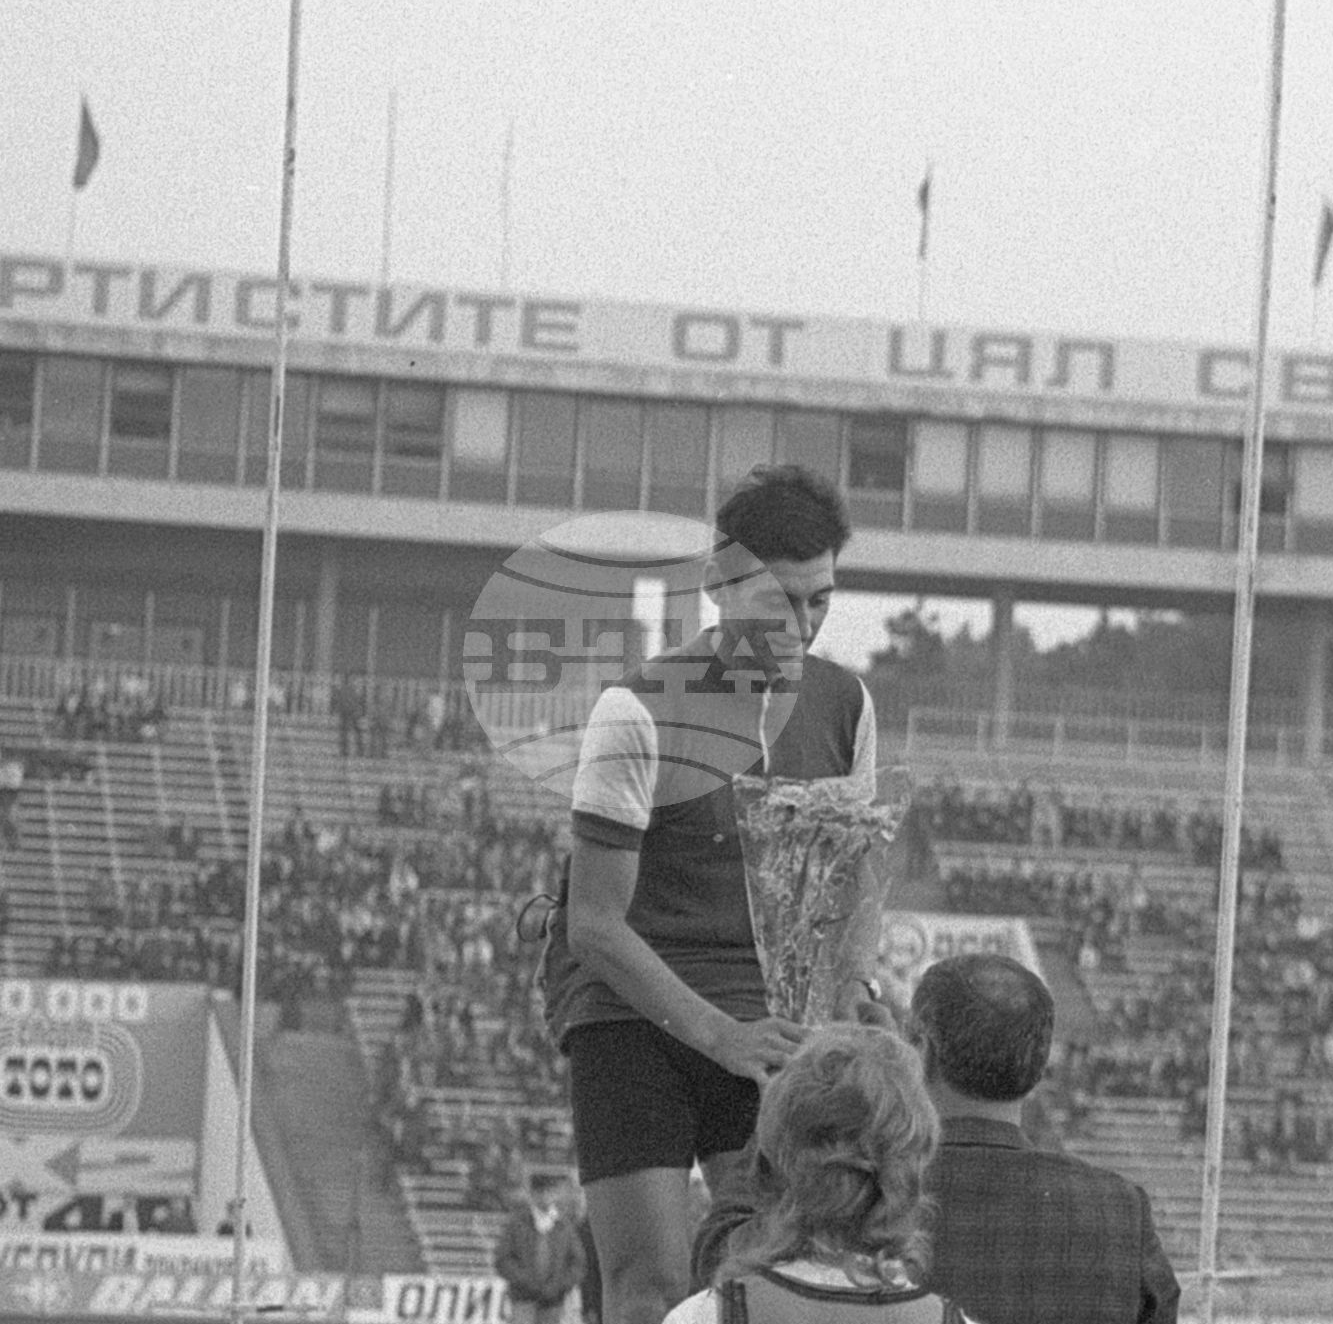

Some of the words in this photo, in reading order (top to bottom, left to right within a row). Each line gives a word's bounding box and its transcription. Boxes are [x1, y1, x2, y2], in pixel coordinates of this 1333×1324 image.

[0, 259, 583, 352] РТИСТИТЕ
[671, 311, 804, 367] ОТ
[888, 325, 1116, 392] ЦЯЛ
[4, 1056, 104, 1102] ТОТО
